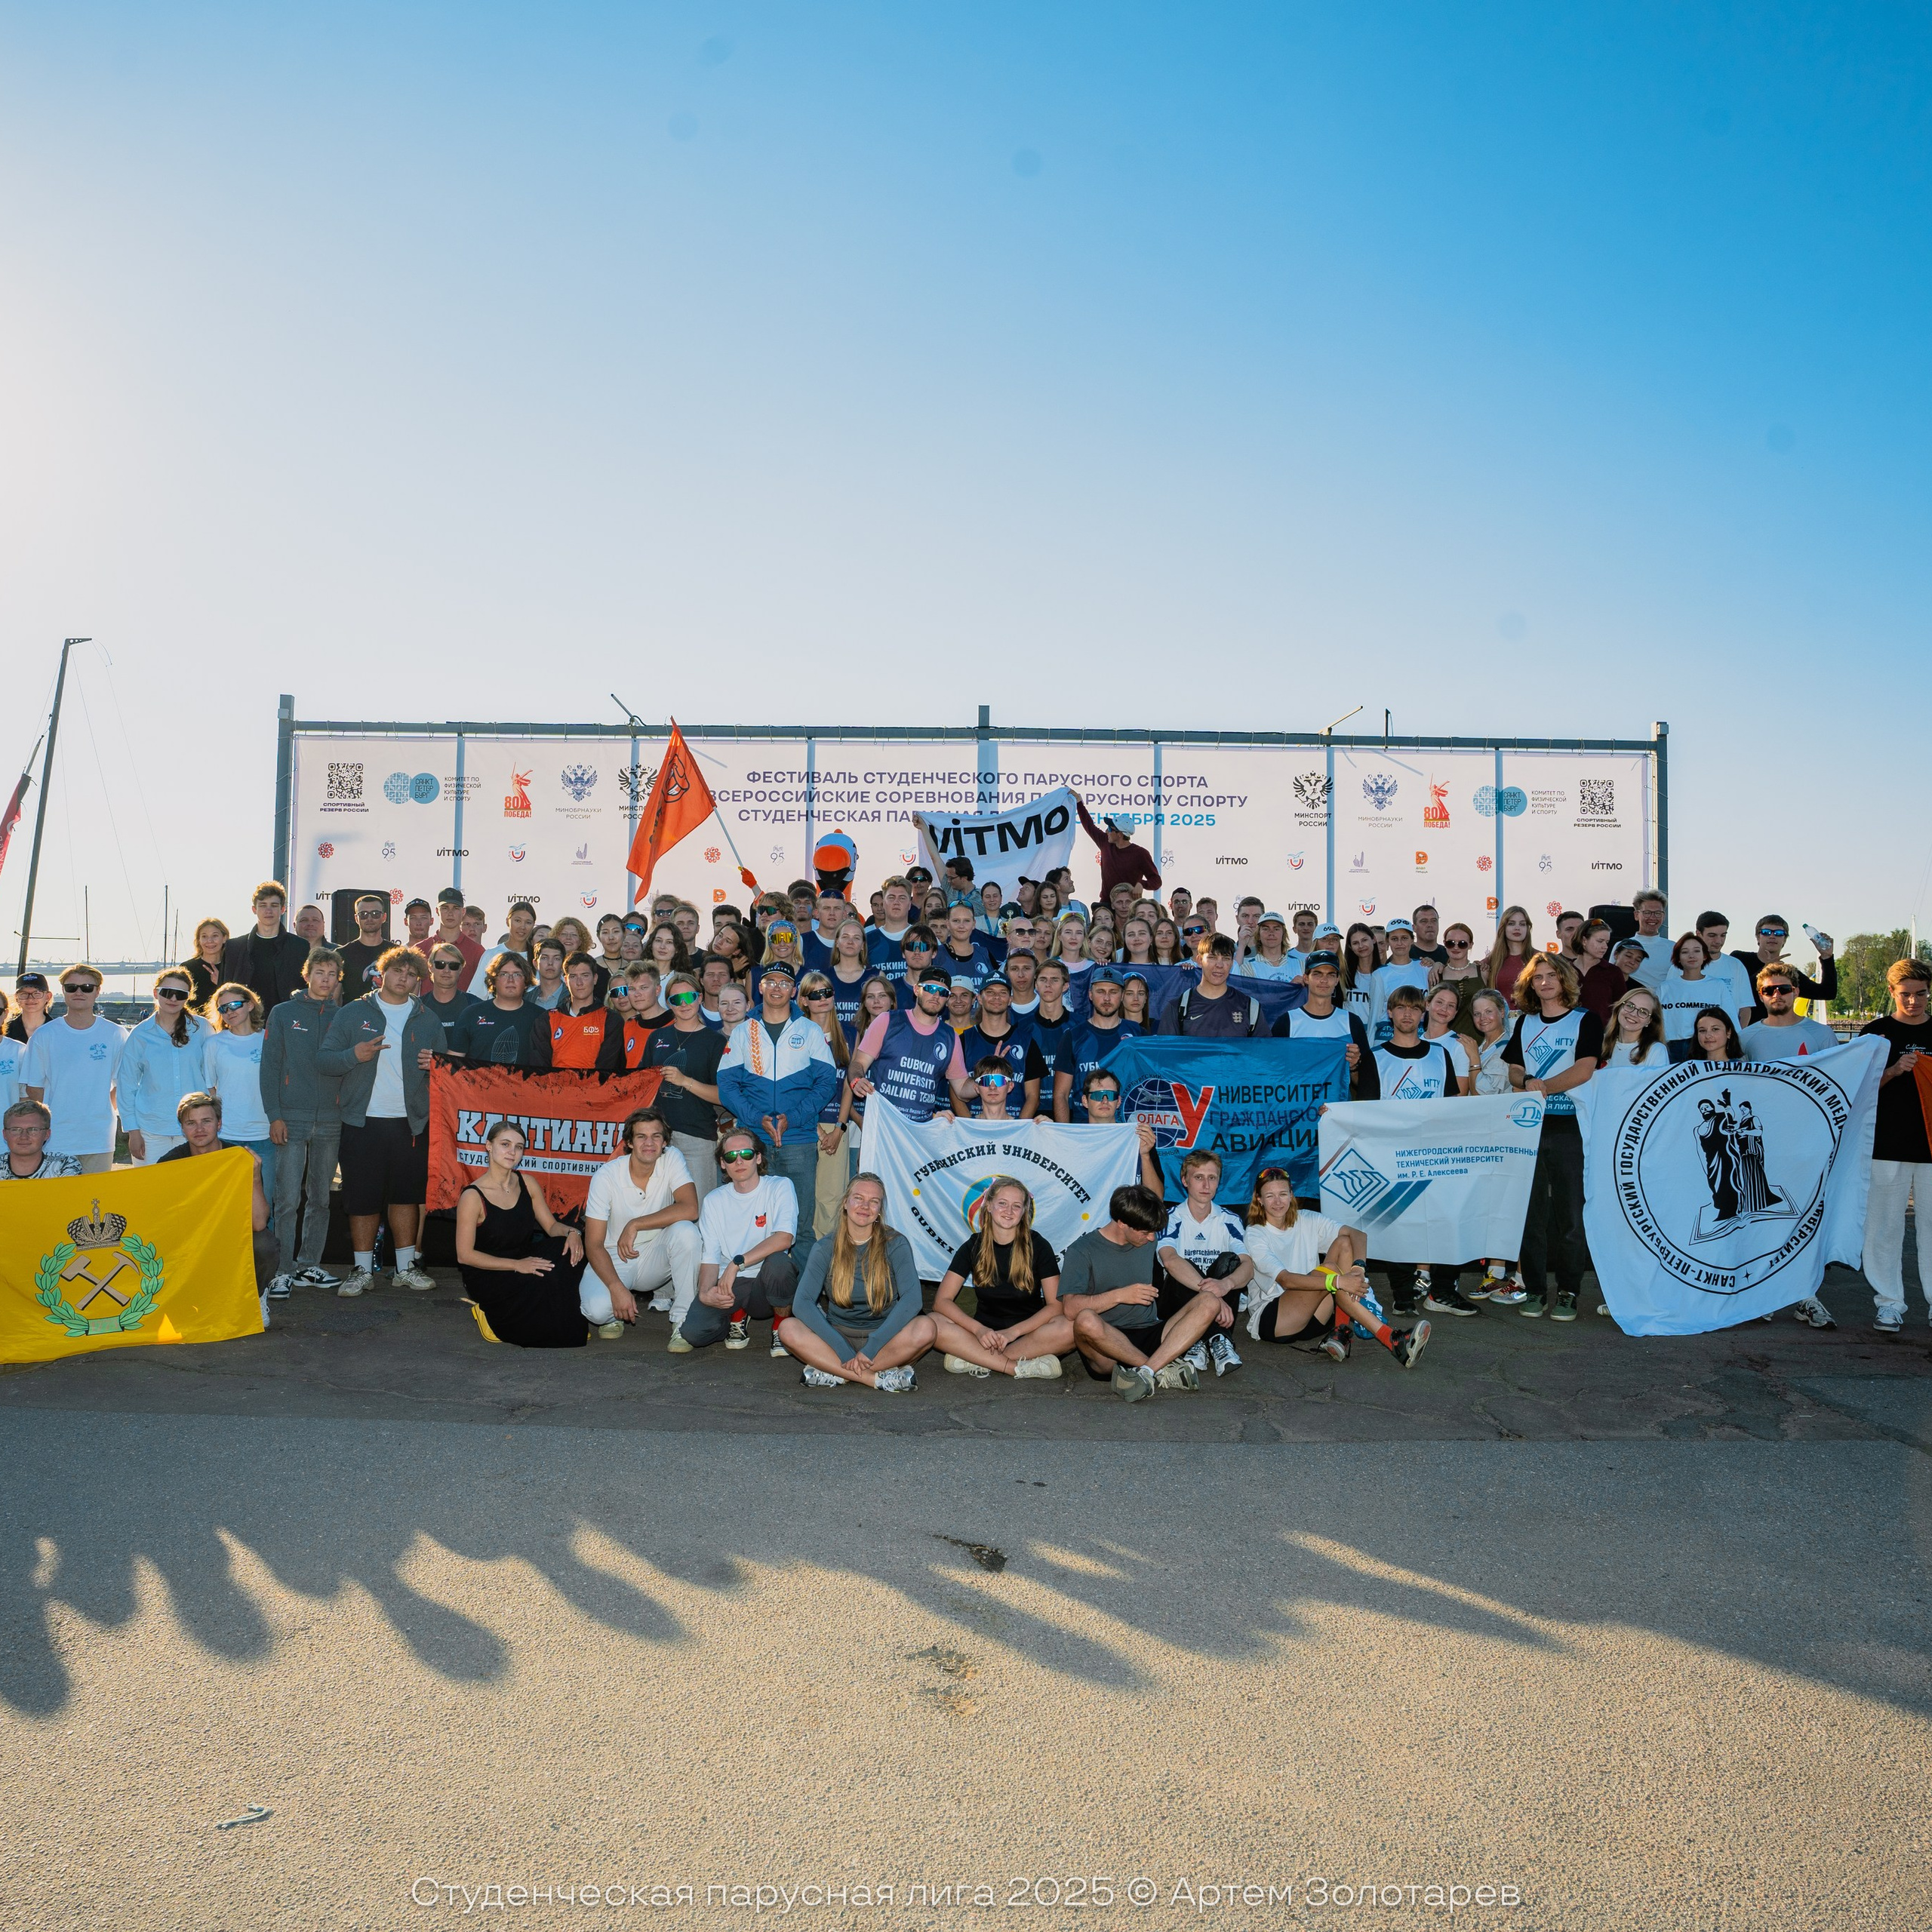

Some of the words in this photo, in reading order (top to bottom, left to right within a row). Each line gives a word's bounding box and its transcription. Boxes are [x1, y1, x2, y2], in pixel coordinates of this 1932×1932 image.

[746, 771, 858, 784] ФЕСТИВАЛЬ
[863, 771, 1018, 786] СТУДЕНЧЕСКОГО
[1023, 774, 1132, 787] ПАРУСНОГО
[1137, 775, 1208, 788] СПОРТА
[504, 796, 521, 809] 80
[875, 790, 1025, 804] СОРЕВНОВАНИЯ
[1177, 794, 1247, 808] СПОРТУ
[738, 809, 881, 823] СТУДЕНЧЕСКАЯ
[1171, 814, 1216, 826] 2025
[1424, 807, 1438, 820] 80
[1555, 1038, 1575, 1047] НГТУ
[900, 1057, 935, 1075] GUBKIN
[879, 1082, 917, 1101] SAILING
[1209, 1107, 1319, 1129] ГРАЖДАНСКО
[1620, 1060, 1700, 1177] ГОСУДАРСТВЕННЫЙ
[1396, 1146, 1463, 1157] НИЖЕГОРОДСКИЙ
[1396, 1156, 1449, 1168] ТЕХНИЧЕСКИЙ
[1451, 1155, 1504, 1164] УНИВЕРСИТЕТ
[1002, 1144, 1091, 1204] УНИВЕРСИТЕТ
[1428, 1168, 1468, 1177] Алексеева
[911, 1206, 958, 1254] GUBKI
